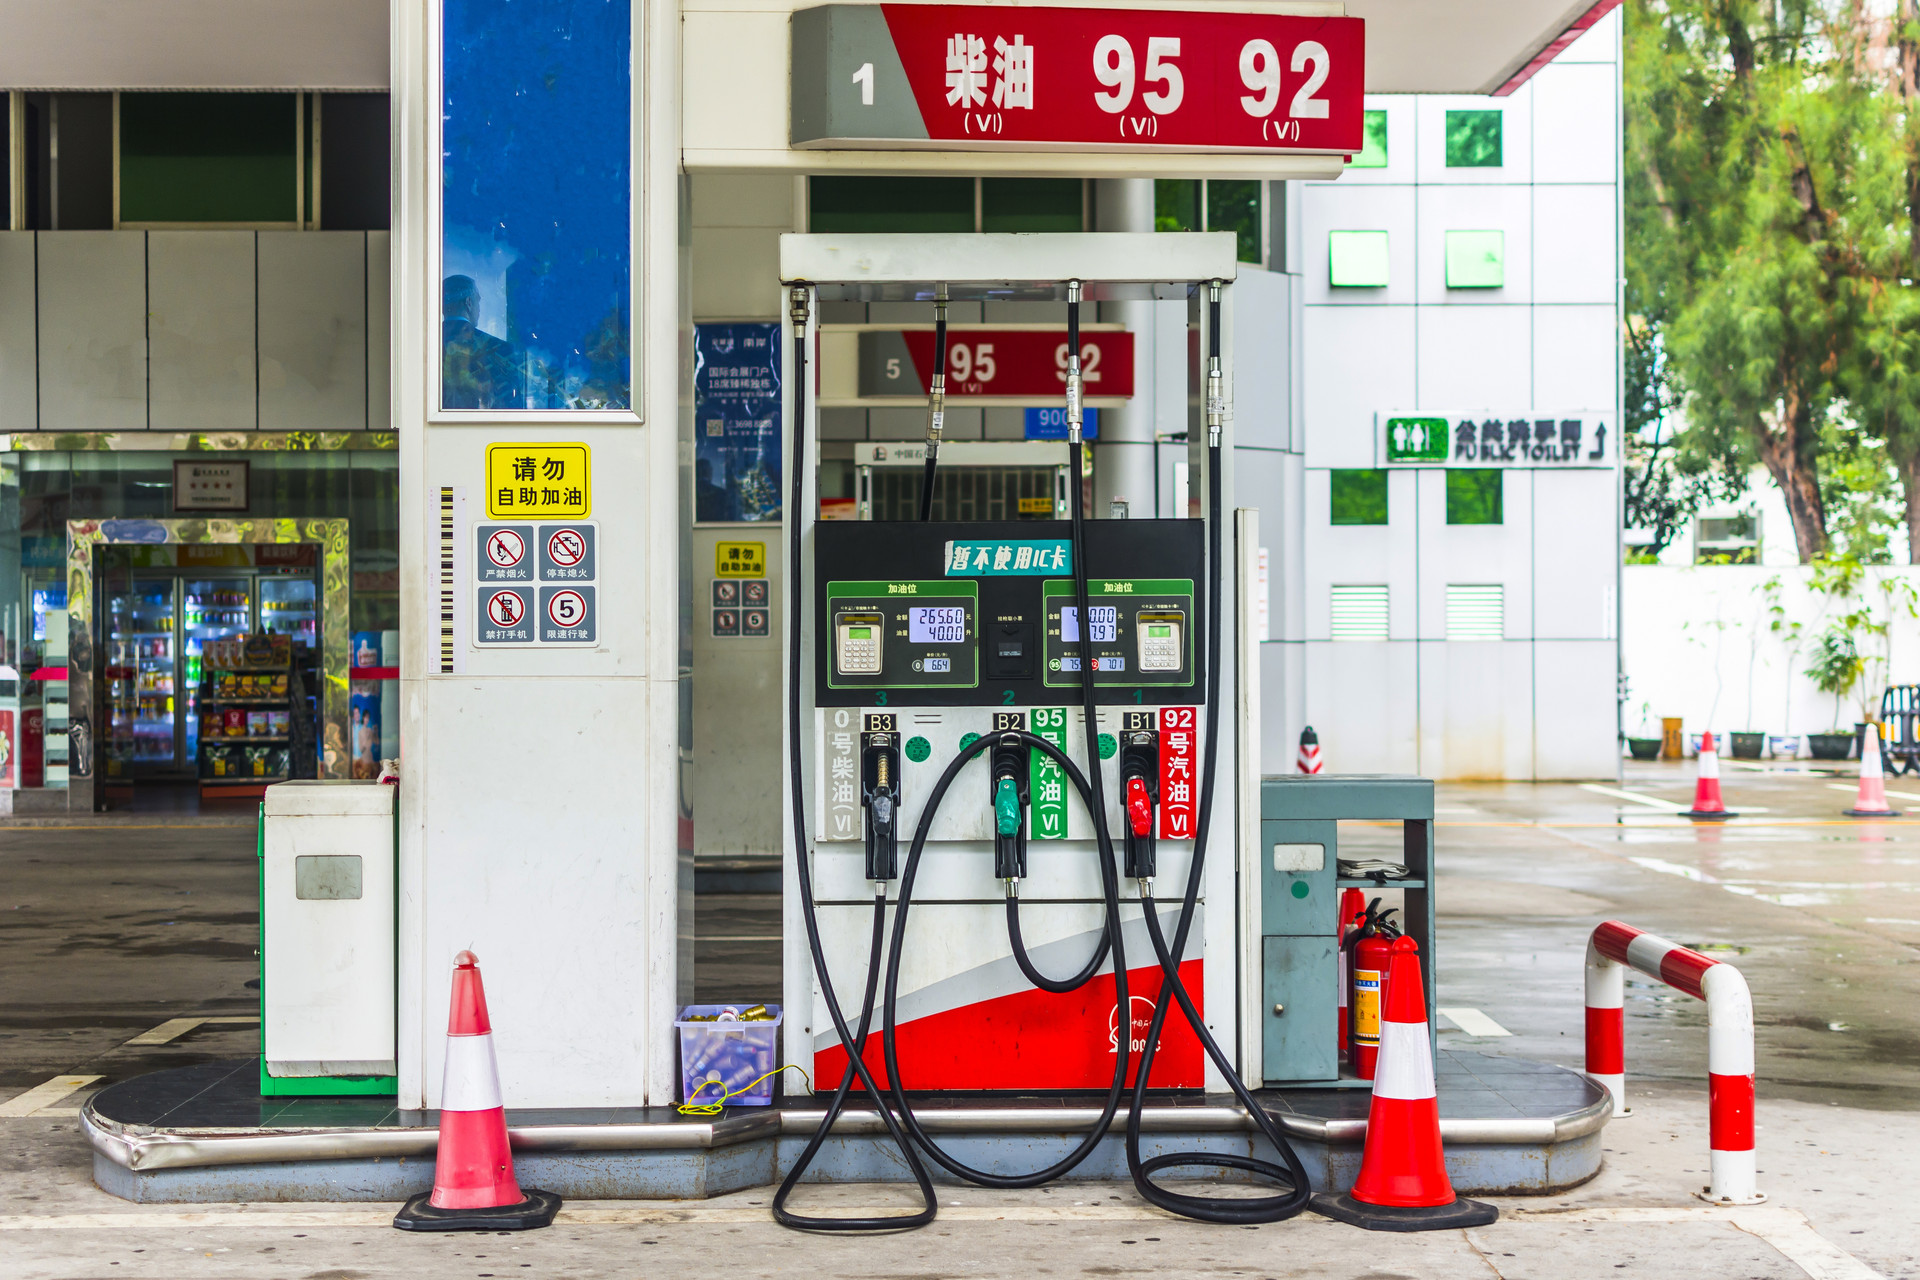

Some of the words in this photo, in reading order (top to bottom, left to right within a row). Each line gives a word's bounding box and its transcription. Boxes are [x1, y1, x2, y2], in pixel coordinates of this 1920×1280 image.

[946, 33, 1034, 111] 柴油
[1093, 34, 1184, 115] 95
[1238, 39, 1330, 119] 92
[852, 63, 874, 105] 1
[886, 359, 900, 379] 5
[951, 343, 996, 382] 95
[1055, 344, 1101, 382] 92
[894, 449, 927, 459] 中国石
[1455, 444, 1516, 460] PUBLIC
[1521, 444, 1581, 460] TOILET
[512, 457, 565, 481] 请勿
[498, 487, 582, 506] 自助加油
[728, 547, 754, 560] 请勿
[952, 545, 1066, 570] 暂不使用IC卡
[485, 569, 527, 578] 严禁烟火
[546, 568, 588, 578] 停车熄火
[888, 583, 917, 594] 加油位
[1104, 582, 1133, 593] 加油位
[560, 599, 574, 618] 5
[919, 609, 962, 624] 265.60
[1071, 608, 1115, 623] 40.00
[751, 615, 759, 625] 5
[485, 629, 527, 639] 禁打手机
[547, 629, 588, 639] 限速行驶
[929, 625, 962, 641] 40.00
[875, 691, 887, 706] 3
[1002, 690, 1015, 705] 2
[1133, 689, 1142, 704] 1
[871, 715, 891, 731] B3
[998, 714, 1020, 730] B2
[1130, 713, 1149, 729] B1
[1131, 1018, 1152, 1030] 中国石
